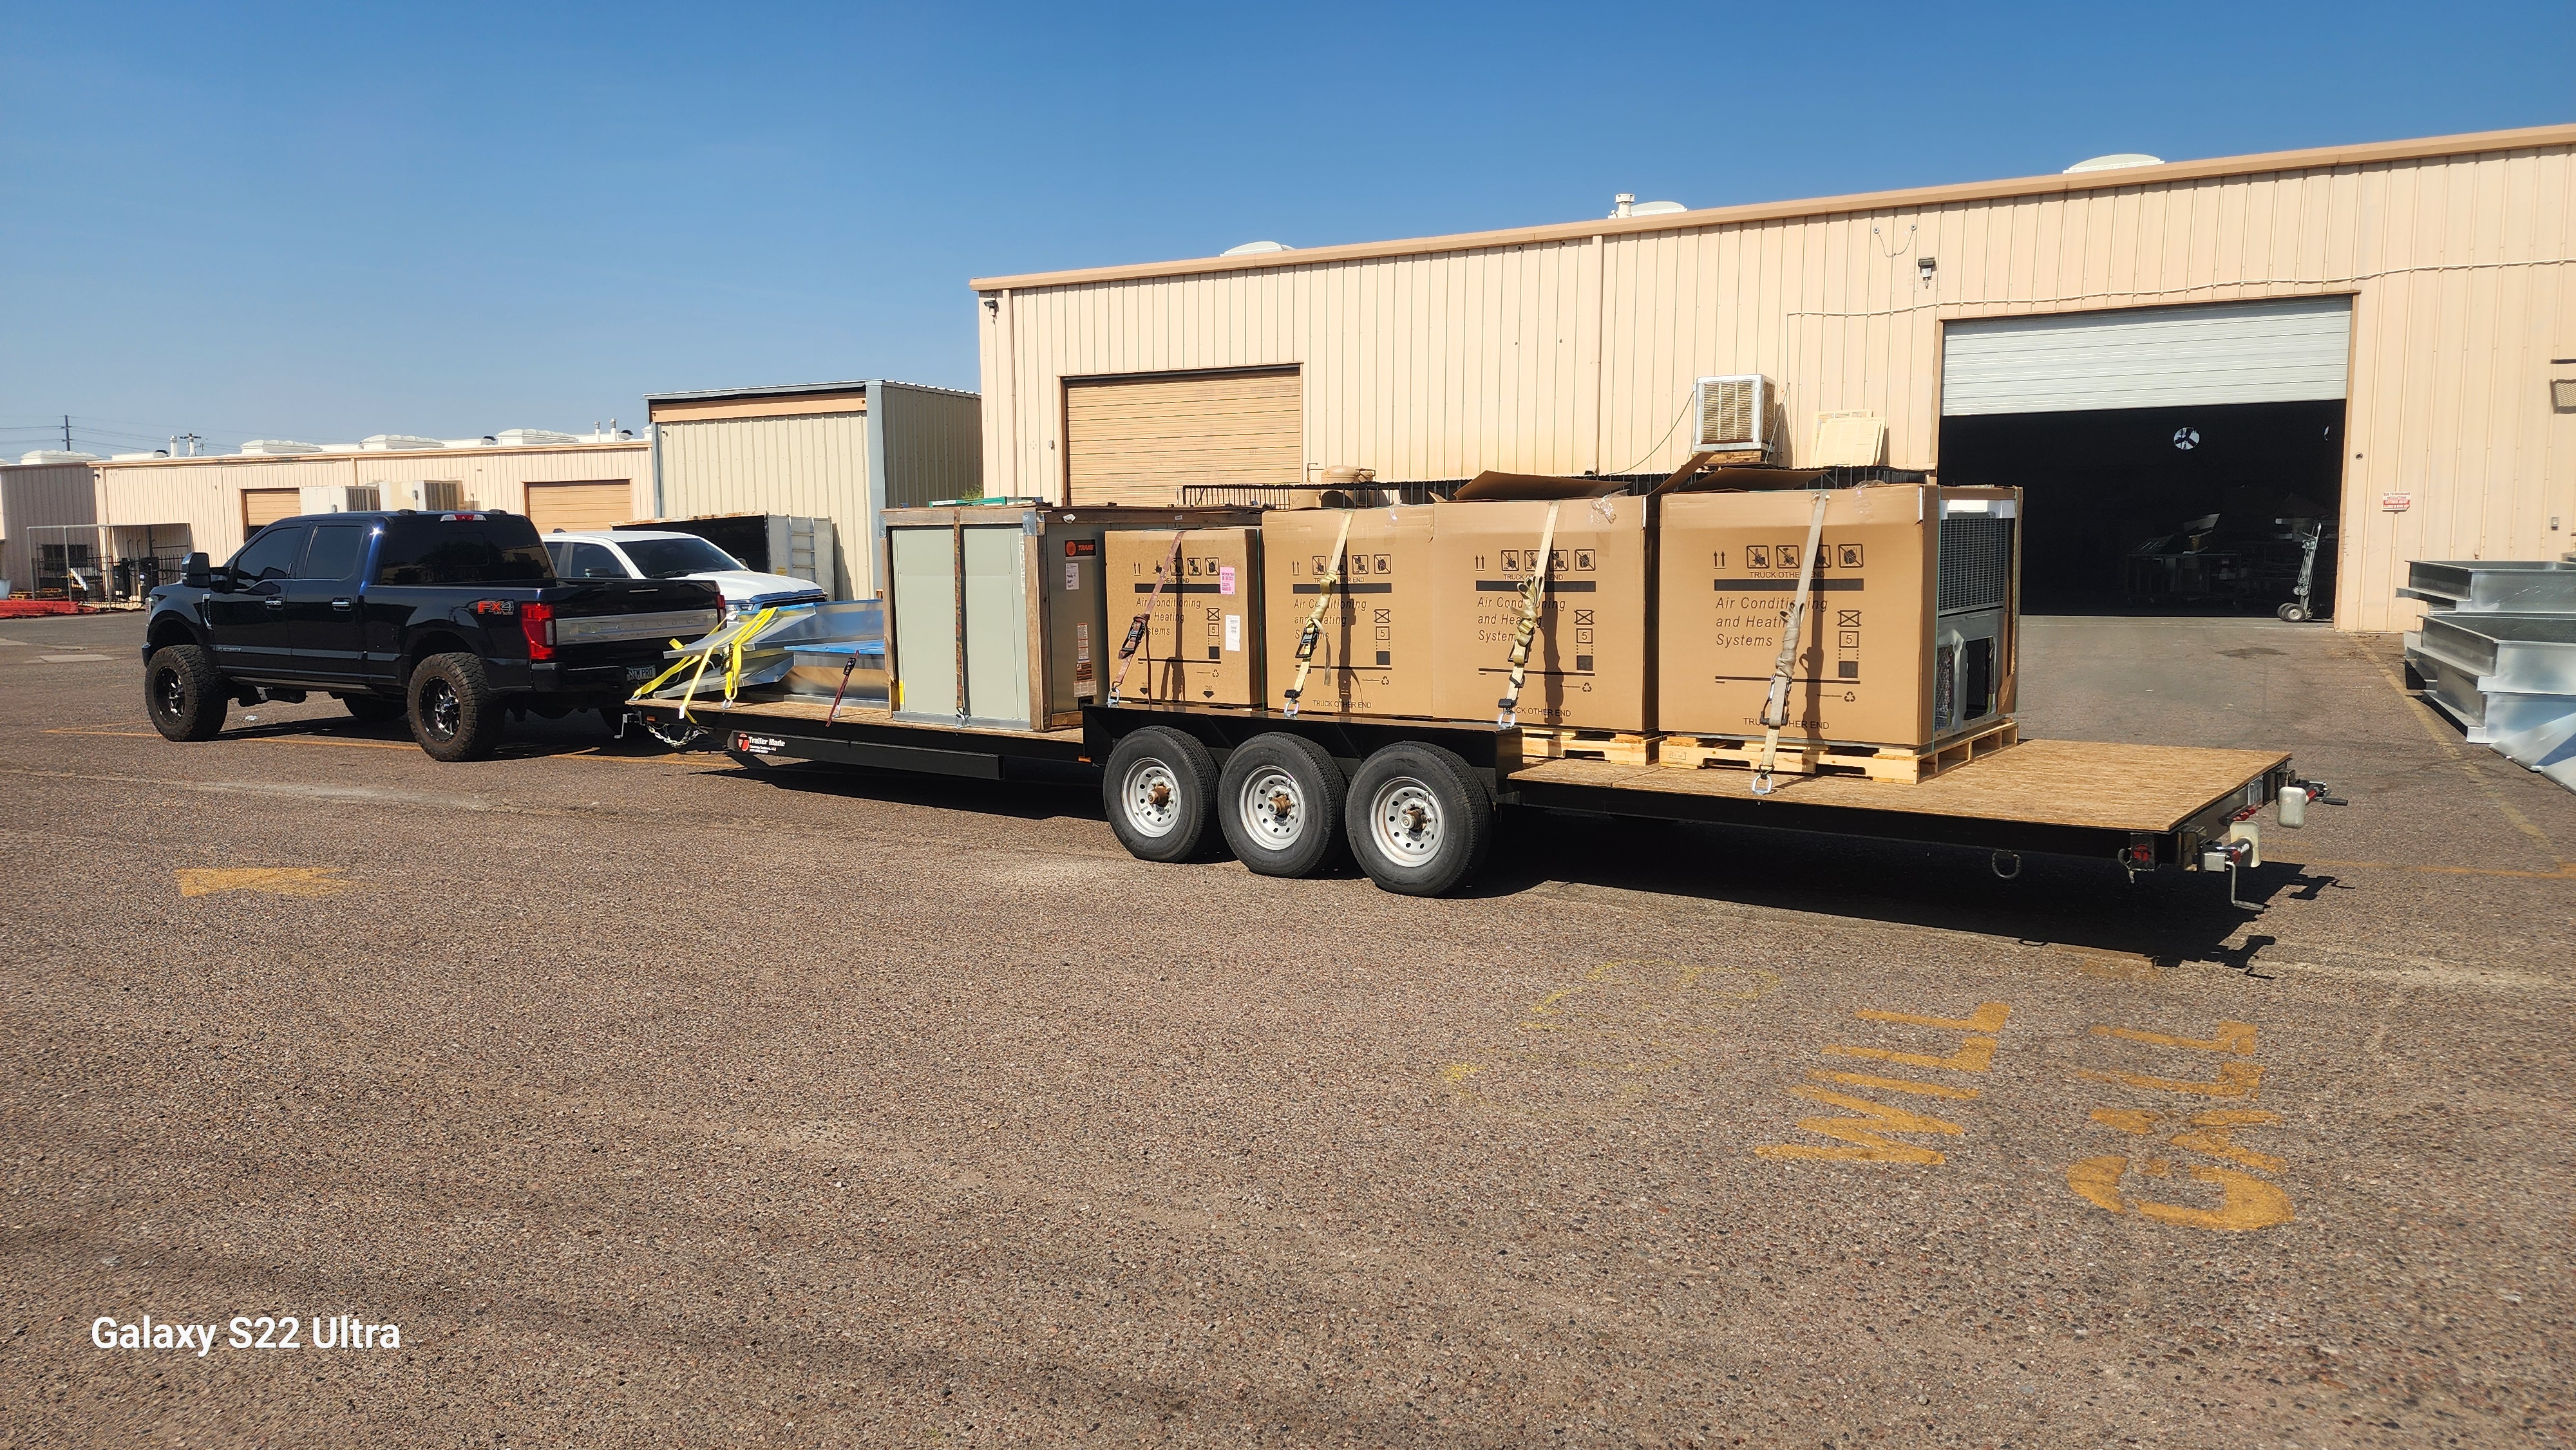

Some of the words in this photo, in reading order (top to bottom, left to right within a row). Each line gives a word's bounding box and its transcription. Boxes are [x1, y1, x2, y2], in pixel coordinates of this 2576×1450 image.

[478, 601, 514, 614] FX4
[1136, 598, 1148, 607] Air
[1155, 598, 1201, 610] onditioning
[1294, 598, 1306, 609] Air
[1477, 596, 1493, 608] Air
[1716, 597, 1736, 609] Air
[1154, 612, 1185, 623] Heating
[1323, 615, 1347, 627] ating
[1477, 614, 1497, 625] and
[1716, 616, 1740, 628] and
[585, 619, 694, 631] PLATINUM
[1147, 627, 1171, 636] stems
[1582, 632, 1587, 641] 5
[1716, 634, 1773, 648] Systems
[1846, 634, 1853, 645] 5
[642, 668, 653, 677] PRO
[1528, 708, 1554, 717] OTHER
[1555, 709, 1571, 717] END
[1810, 721, 1830, 730] END
[1753, 1002, 2011, 1165] WILL
[2066, 1021, 2295, 1230] CALL
